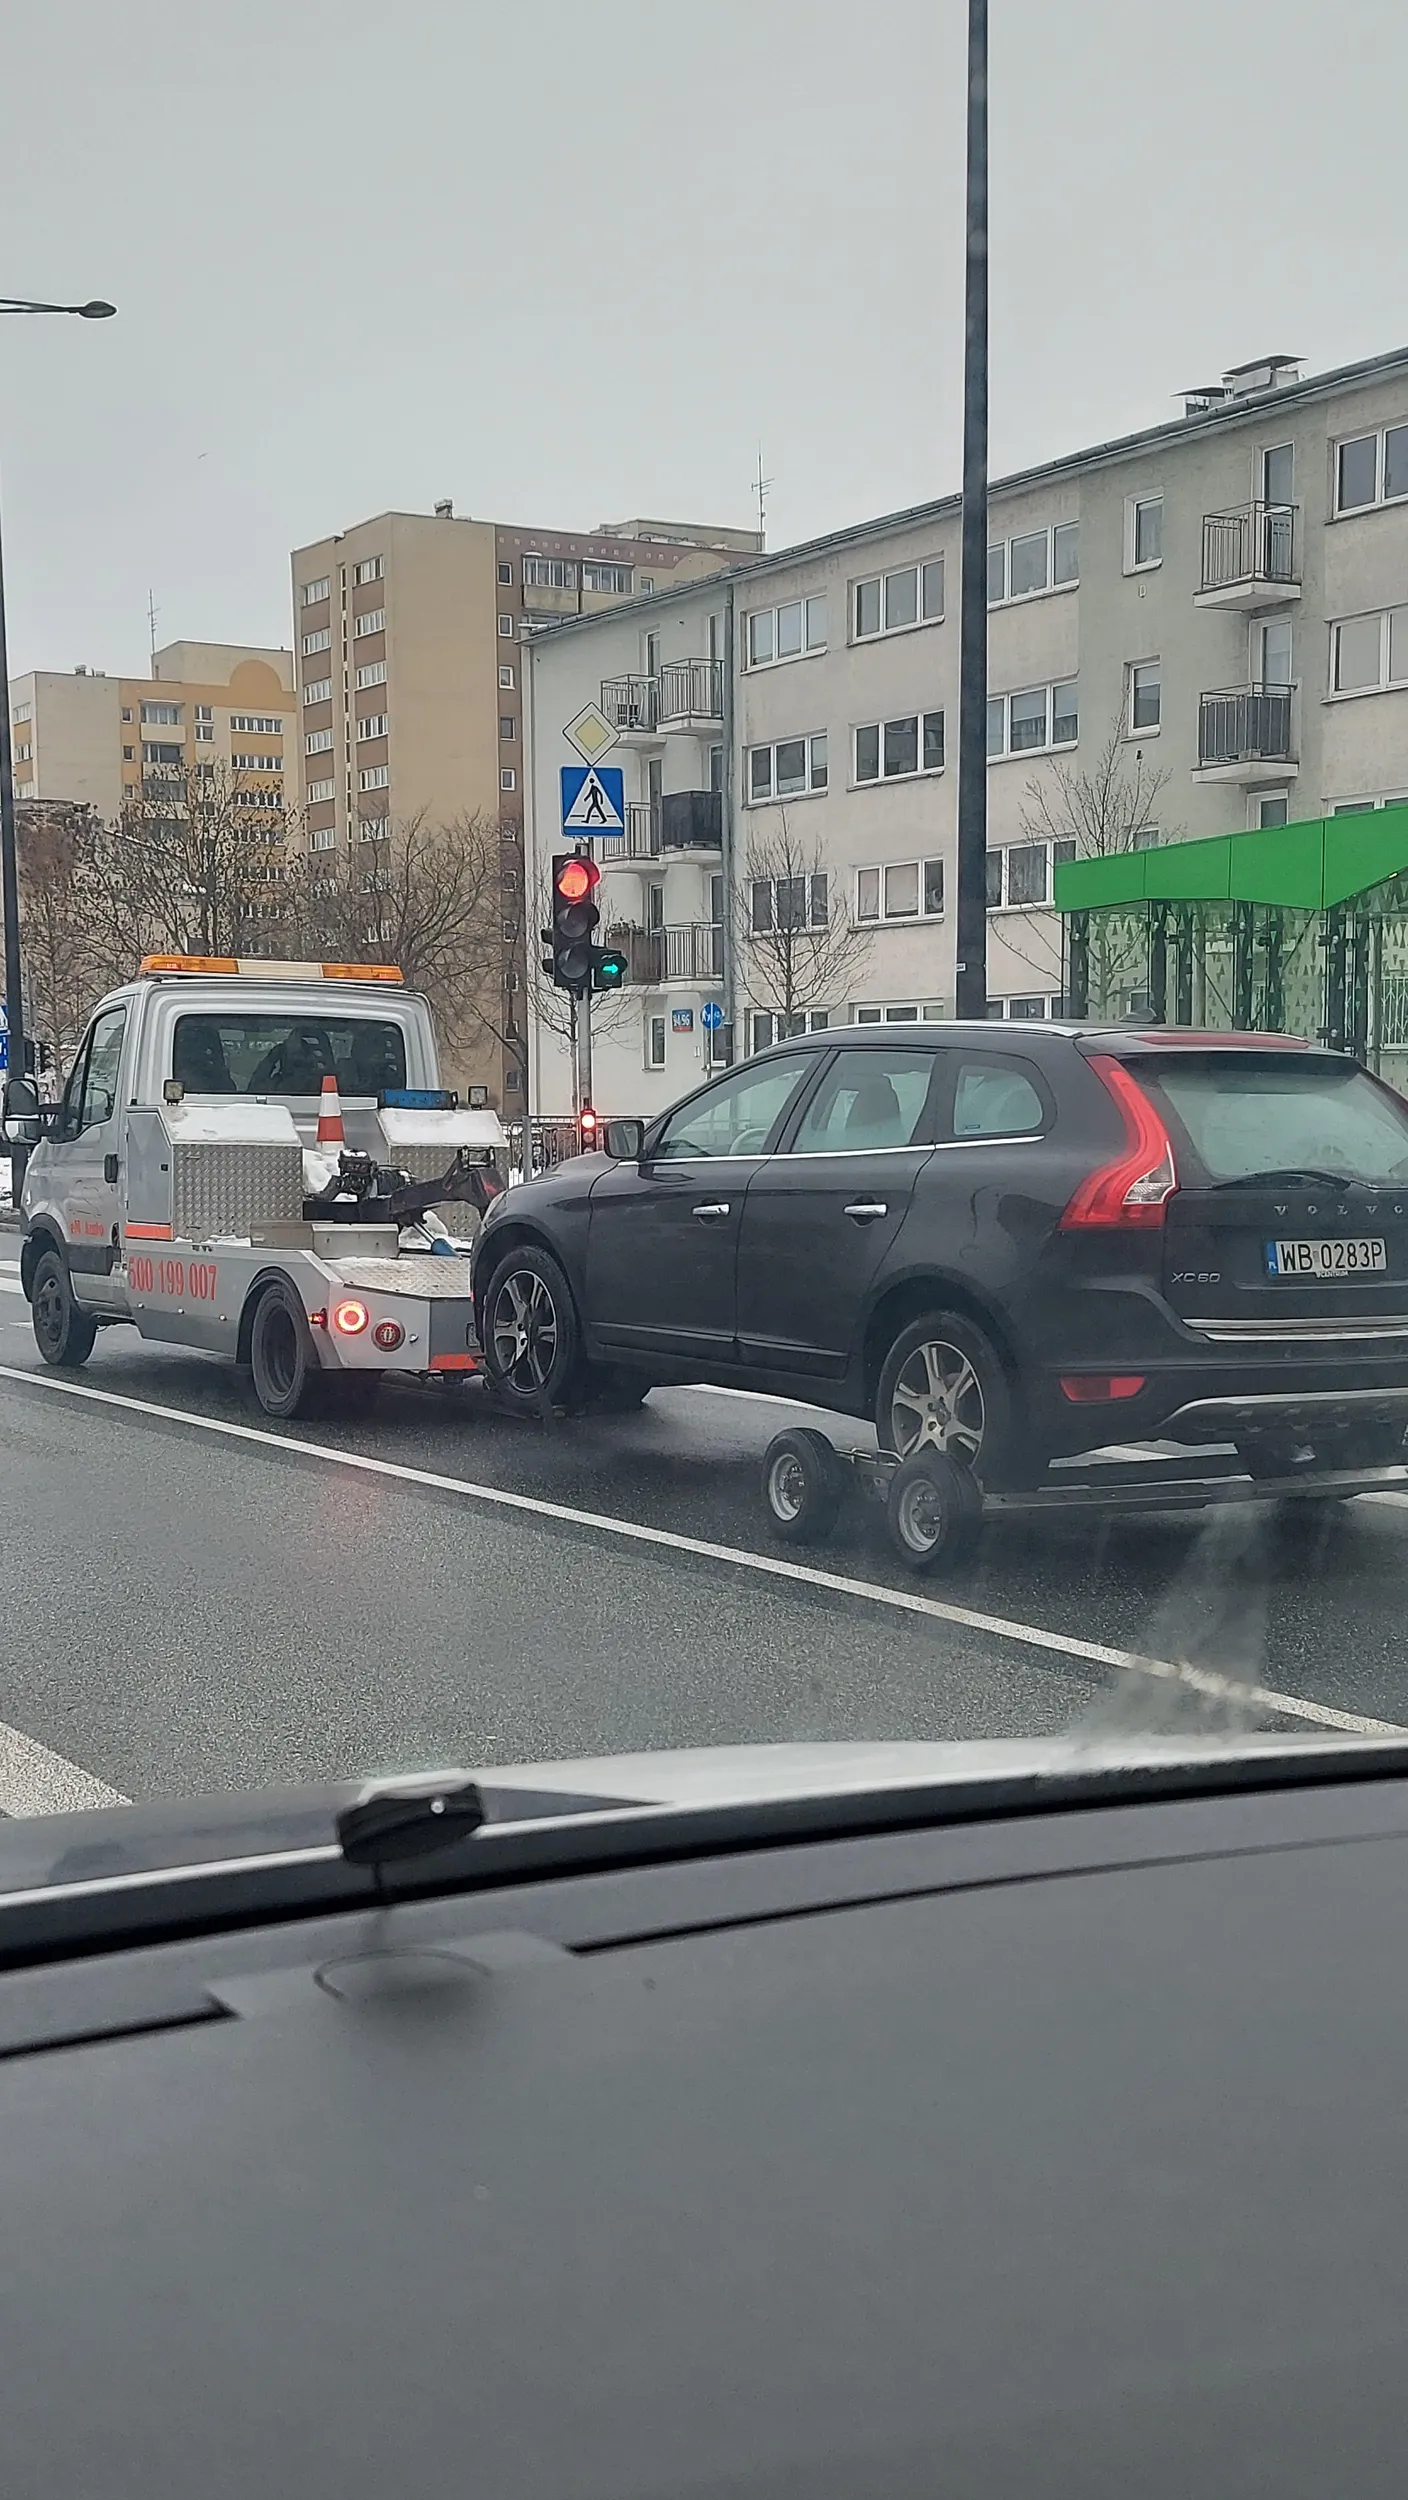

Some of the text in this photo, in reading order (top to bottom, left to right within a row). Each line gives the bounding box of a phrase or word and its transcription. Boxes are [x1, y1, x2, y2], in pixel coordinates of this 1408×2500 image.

[1274, 1205, 1403, 1215] VOLVO
[1280, 1241, 1382, 1271] WB 0283P
[158, 1259, 184, 1296] 199
[188, 1262, 217, 1301] 007
[1171, 1272, 1220, 1283] XC60
